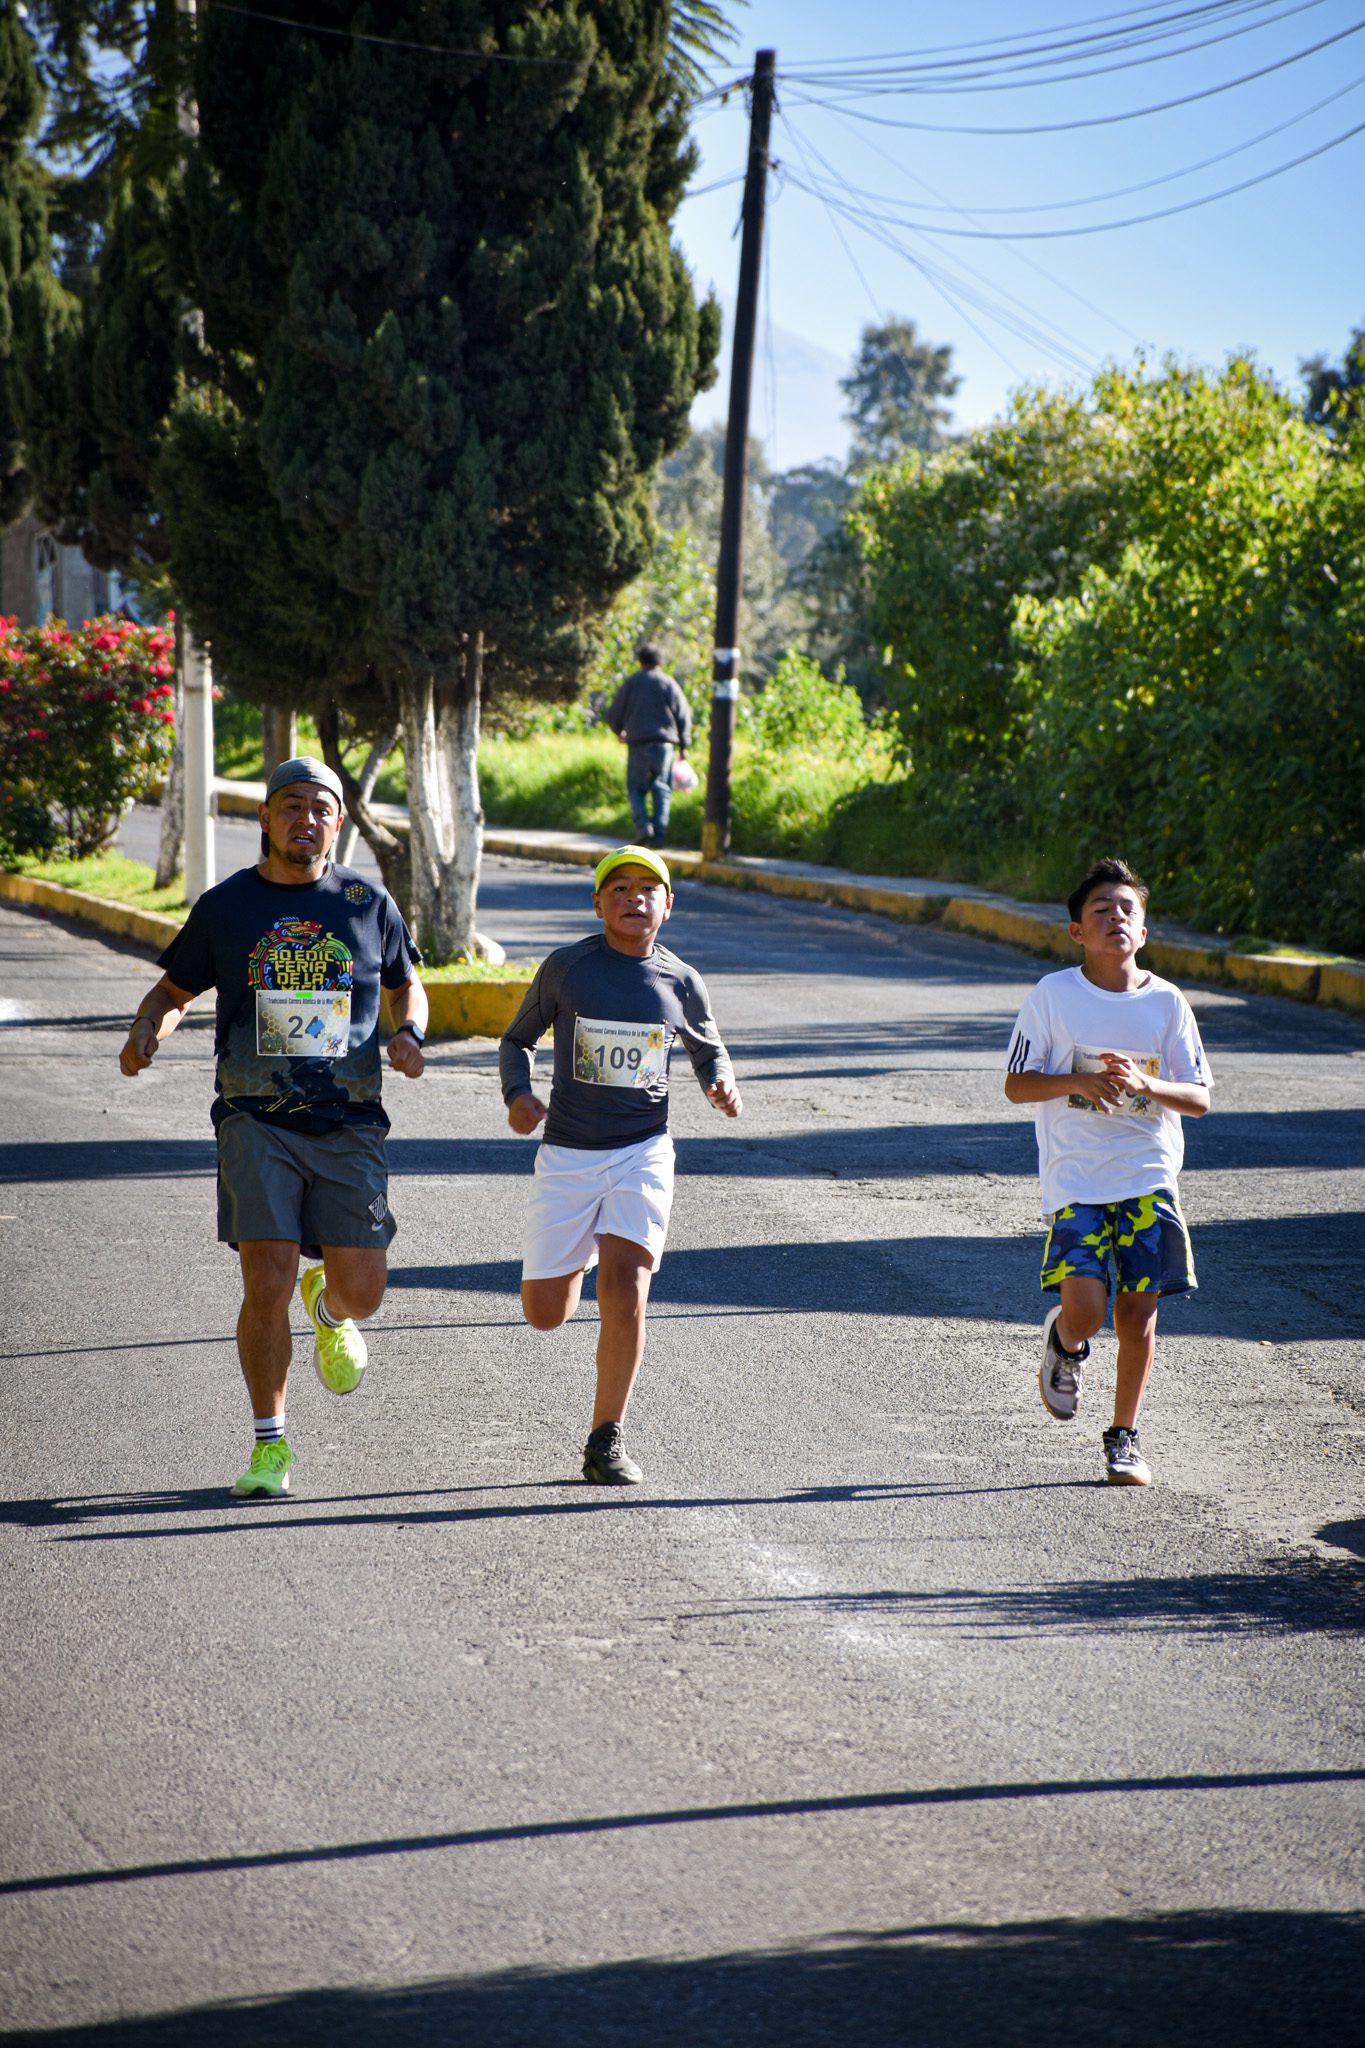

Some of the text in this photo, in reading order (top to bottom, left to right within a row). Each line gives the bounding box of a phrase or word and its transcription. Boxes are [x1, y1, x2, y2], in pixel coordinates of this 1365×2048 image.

[268, 949, 291, 961] 30
[275, 961, 327, 973] FERIA
[277, 973, 324, 985] DE LA
[594, 1045, 642, 1070] 109
